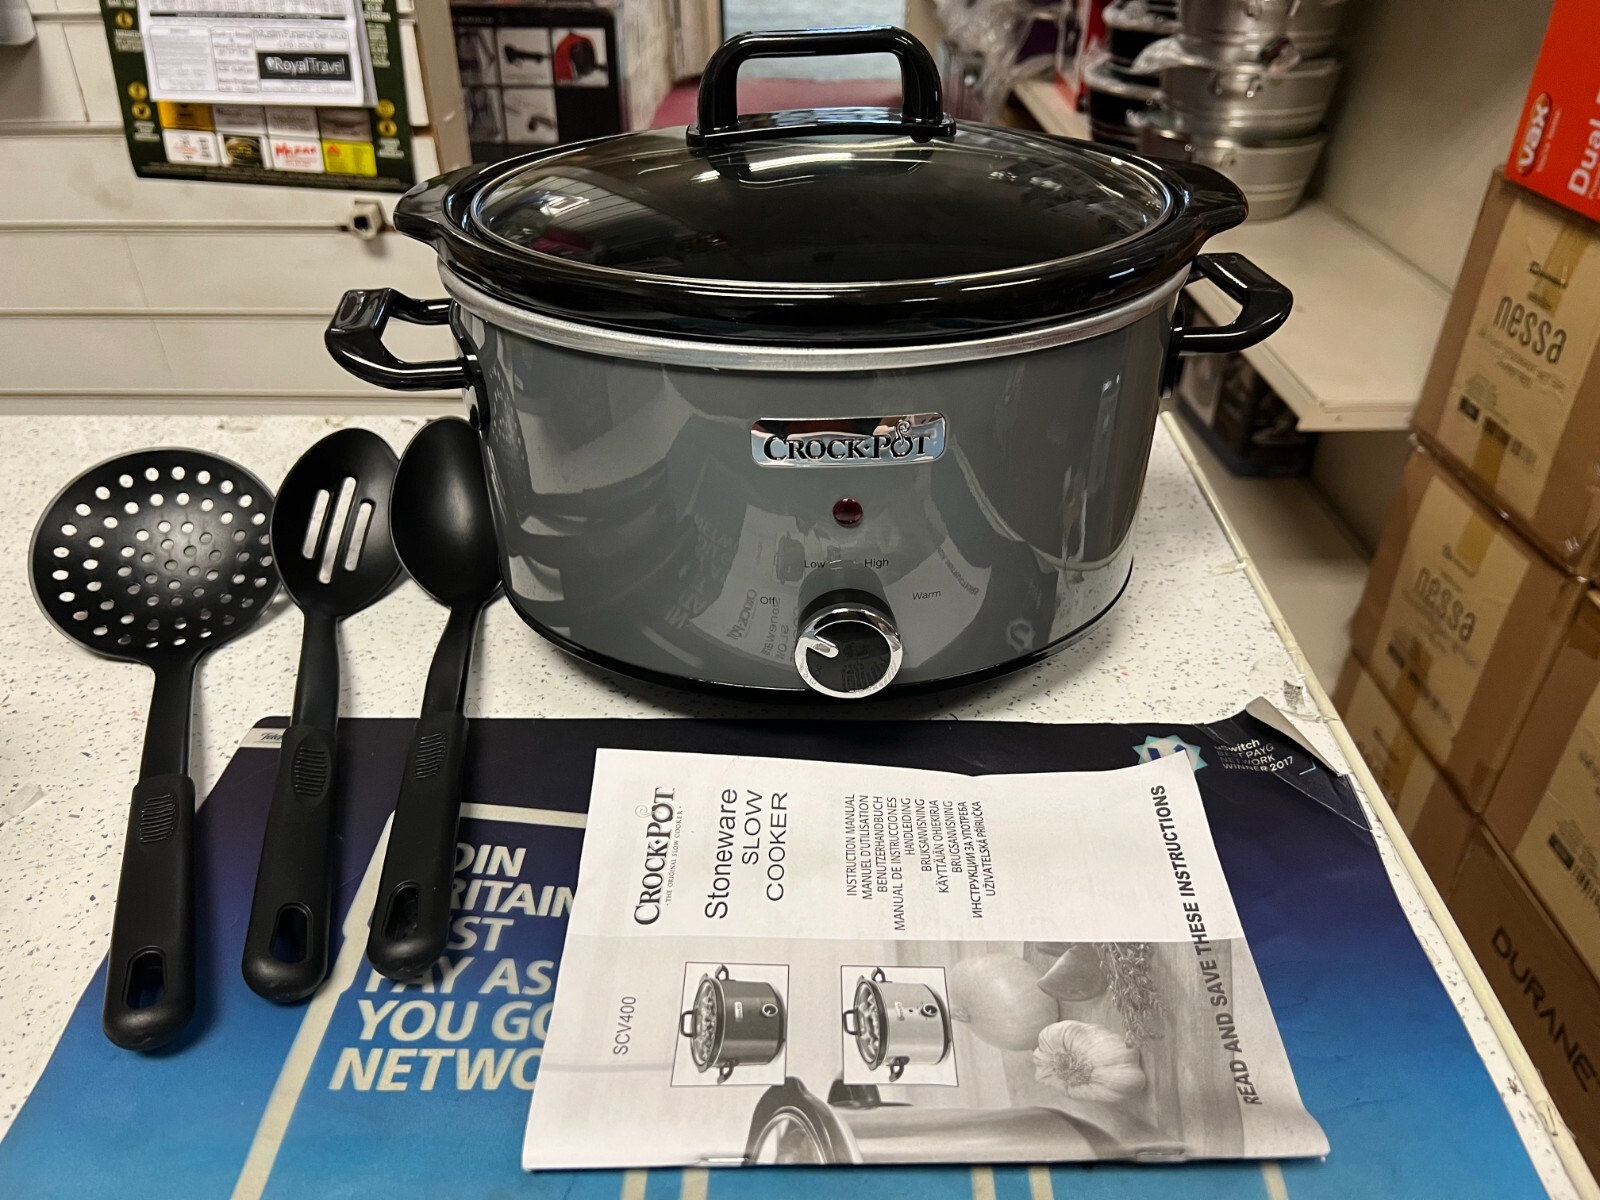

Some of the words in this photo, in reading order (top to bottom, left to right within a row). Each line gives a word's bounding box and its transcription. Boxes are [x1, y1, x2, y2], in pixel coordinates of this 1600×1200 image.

[275, 57, 346, 77] RoyalTravel
[1567, 118, 1600, 196] Dual
[1493, 296, 1567, 364] nessa
[804, 559, 826, 569] Low
[864, 557, 889, 569] High
[759, 596, 777, 605] Off
[912, 589, 942, 601] Warm
[1220, 753, 1276, 766] NETWORK
[1222, 763, 1269, 772] WINNER
[1269, 756, 1294, 772] 2017
[1246, 743, 1275, 758] PAYG
[674, 810, 683, 838] COOKER
[741, 789, 763, 865] SLOW
[845, 794, 856, 835] MANUAL
[887, 796, 901, 864] INSTRUCCIONES
[901, 797, 915, 856] HANDLEIDING
[915, 798, 932, 872] BRUKSANVISNING
[929, 800, 944, 841] OHJEKIRJA
[958, 801, 973, 843] УПОТРЕБА
[671, 840, 679, 857] SLOW
[704, 788, 738, 919] Stoneware
[766, 792, 788, 902] COOKER
[873, 796, 888, 893] BENUTZERHANDBUCH
[943, 800, 963, 873] BRUGSANVISNING
[964, 843, 975, 852] ЗА
[1150, 784, 1196, 898] INSTRUCTIONS
[454, 842, 527, 877] OIN
[668, 857, 677, 888] ORIGINAL
[845, 836, 857, 896] INSTRUCTION
[860, 858, 873, 900] MANUEL
[891, 866, 903, 880] DE
[976, 838, 996, 897] UŽIVATELSKÁ
[665, 889, 673, 903] THE
[965, 853, 983, 918] ИНСТРУКЦИИ
[892, 883, 905, 931] MANUAL
[446, 915, 515, 952] ST
[1183, 902, 1212, 957] THESE
[478, 958, 555, 995] AS
[1200, 958, 1229, 1007] SAVE
[358, 999, 479, 1042] YOU
[612, 996, 637, 1056] SCV400
[1490, 926, 1597, 1093] DURANE
[1216, 1012, 1243, 1054] AND
[328, 1047, 544, 1091] NETWO
[1229, 1059, 1263, 1106] READ
